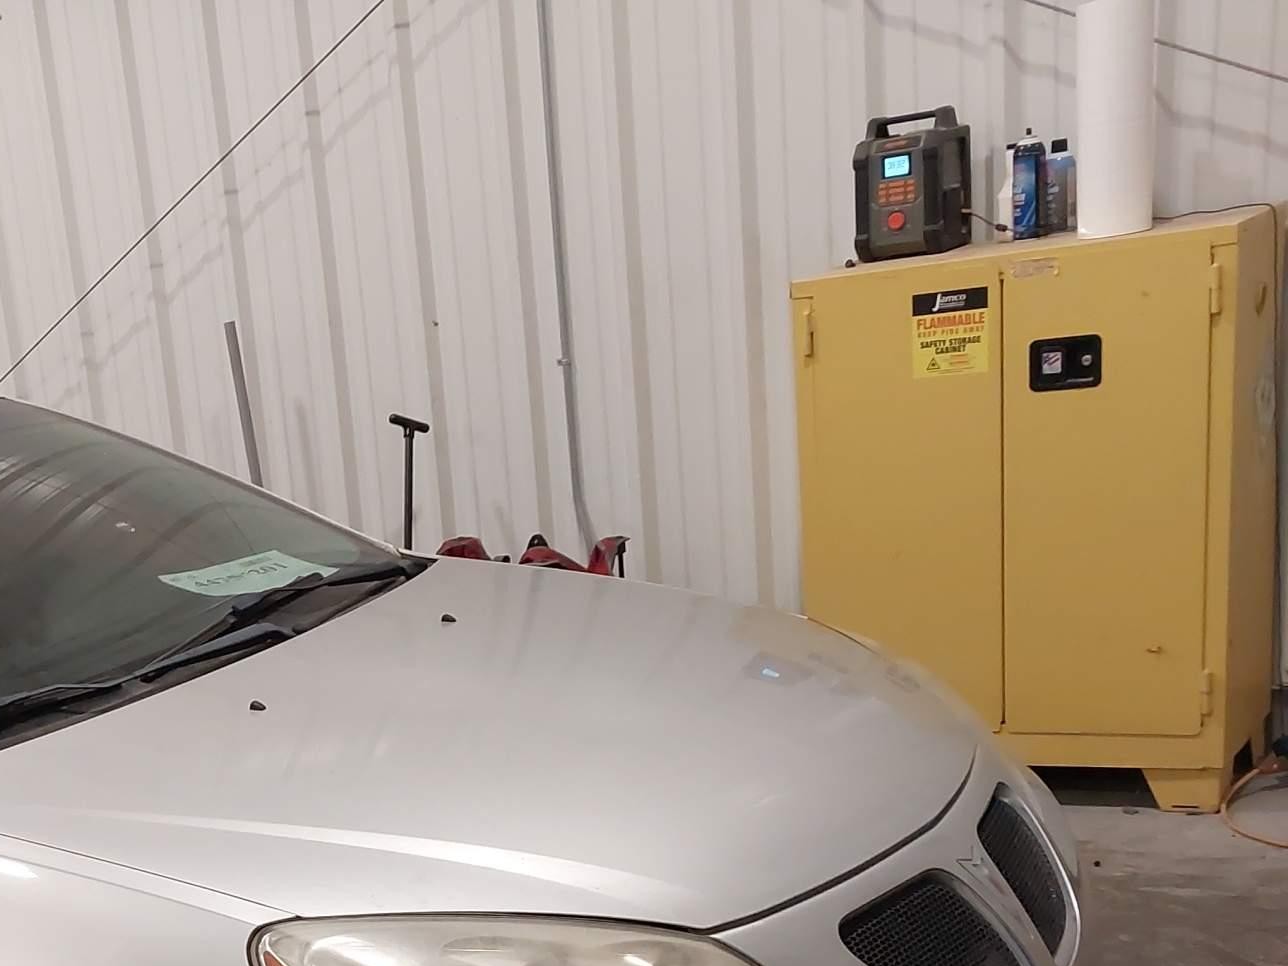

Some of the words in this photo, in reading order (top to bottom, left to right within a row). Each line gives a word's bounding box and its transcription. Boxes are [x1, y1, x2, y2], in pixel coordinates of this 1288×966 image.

[931, 293, 967, 312] Jamco
[916, 312, 985, 331] FLAMMABLE
[920, 339, 946, 349] SAFETY
[949, 335, 981, 346] STORAGE
[935, 344, 966, 355] CABINET
